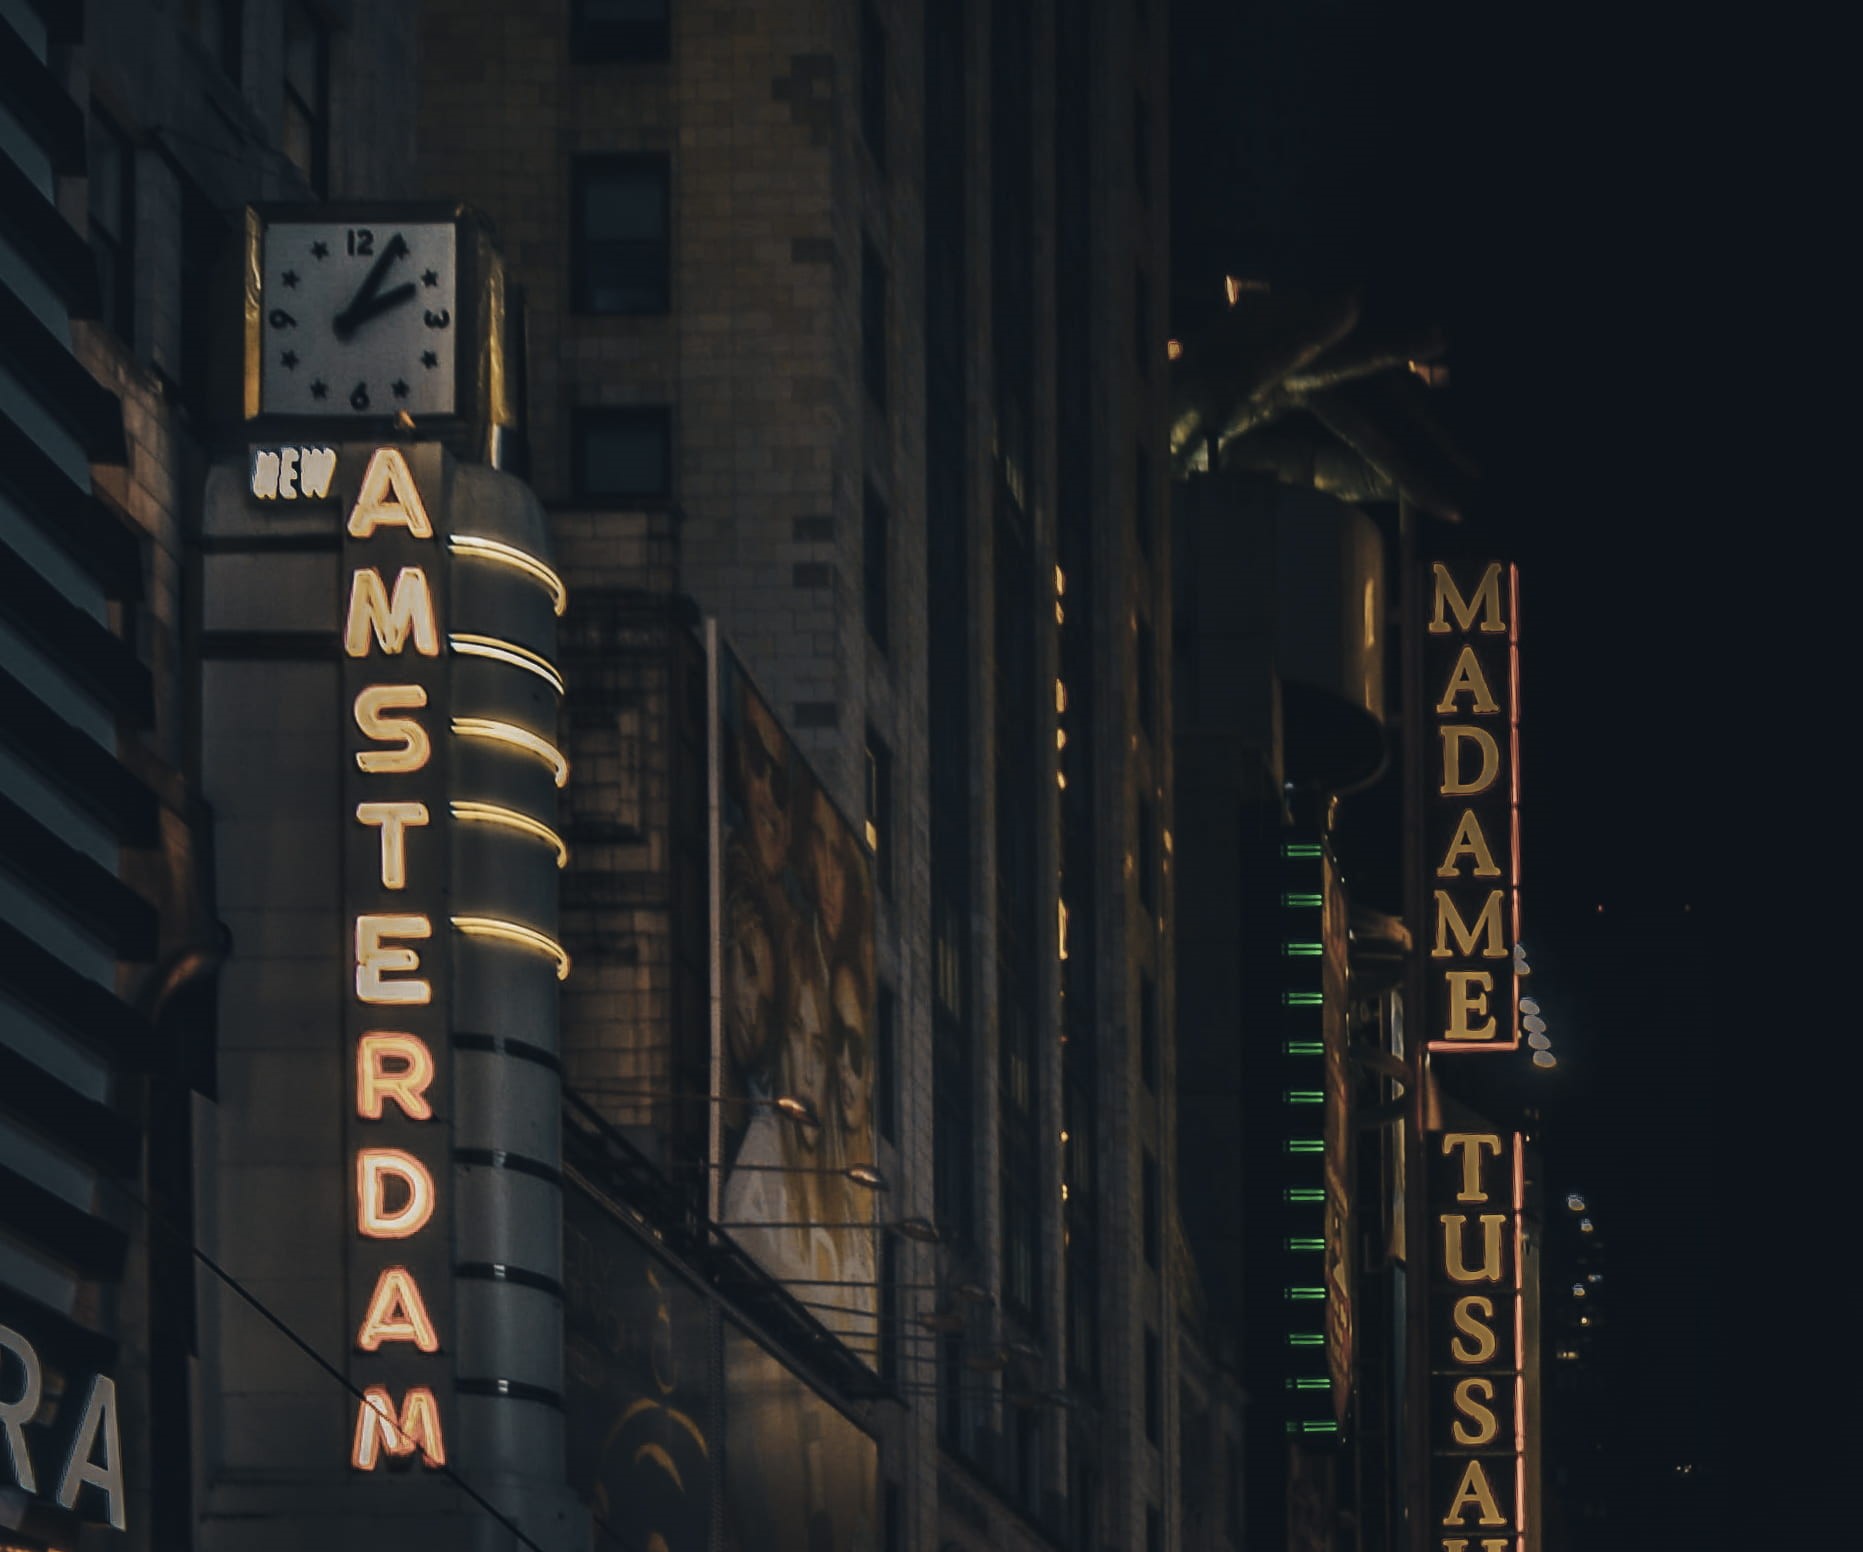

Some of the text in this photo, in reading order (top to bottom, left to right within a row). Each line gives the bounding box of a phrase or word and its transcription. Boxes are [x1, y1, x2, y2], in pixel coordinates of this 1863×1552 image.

[347, 229, 374, 257] 12
[269, 308, 296, 330] 9
[424, 308, 450, 330] 3
[349, 381, 370, 411] 6
[251, 447, 337, 499] NEW
[1429, 561, 1508, 1041] MADAME
[345, 447, 446, 1471] AMSTERDAM
